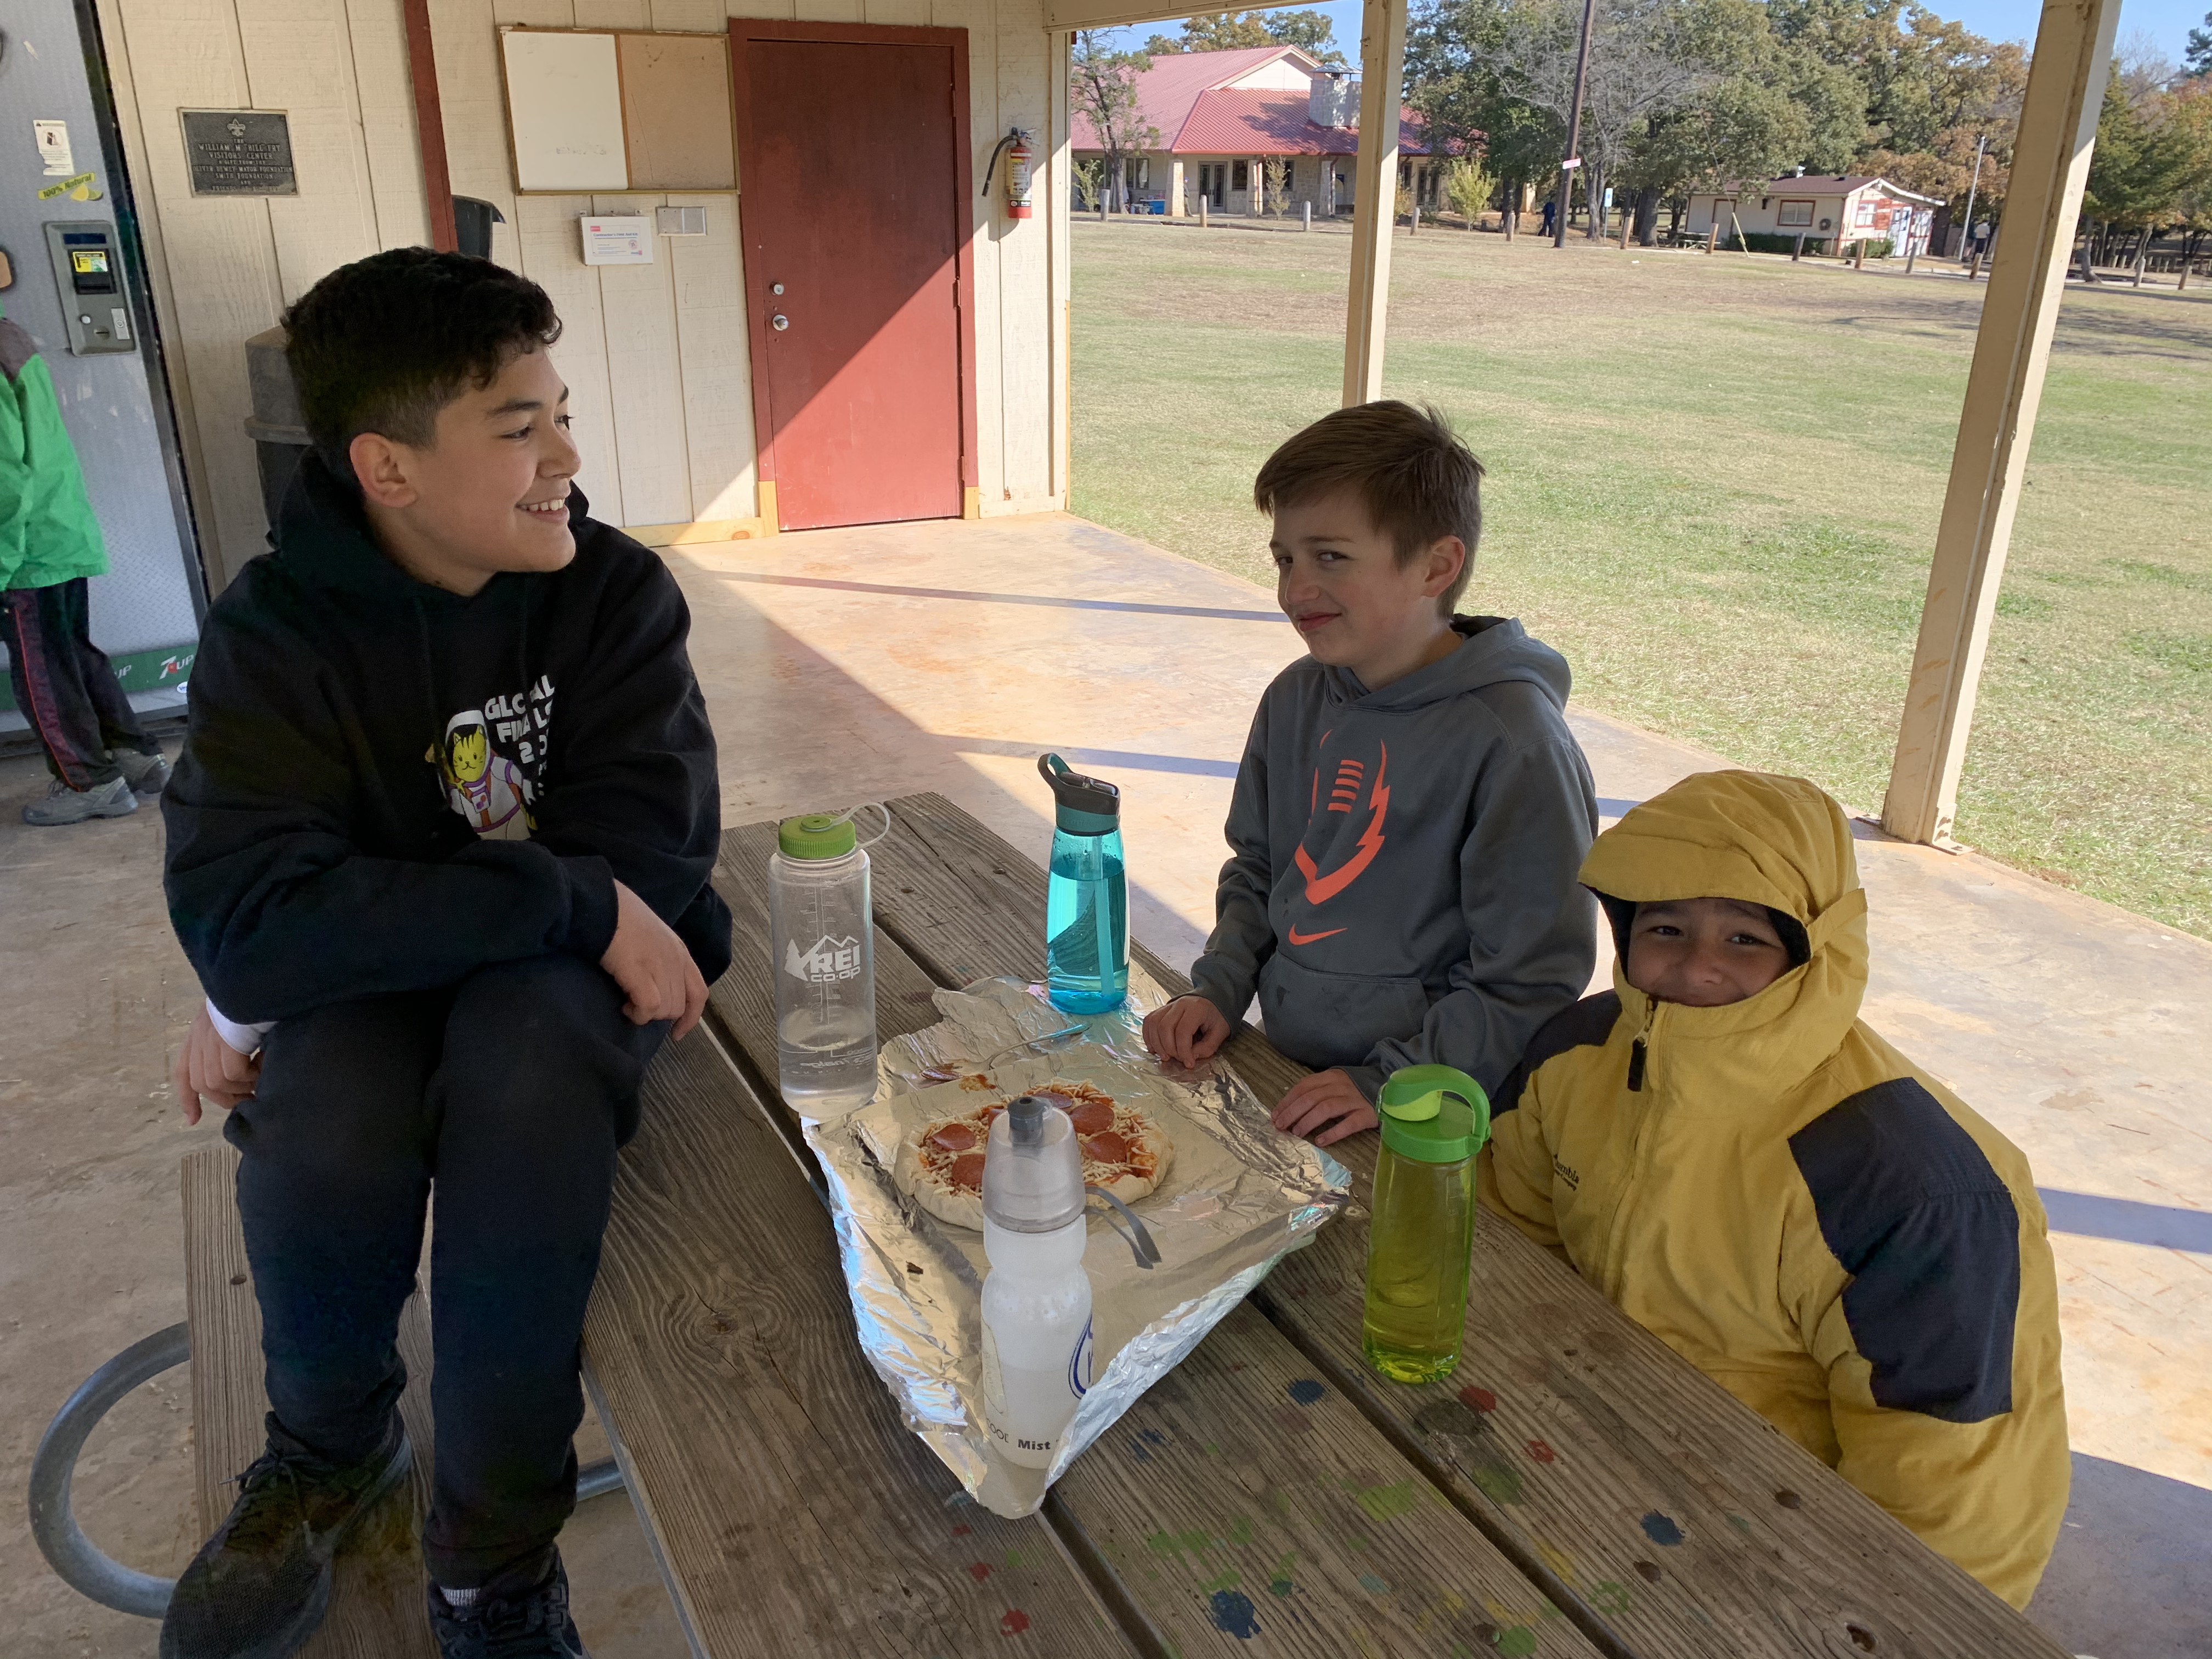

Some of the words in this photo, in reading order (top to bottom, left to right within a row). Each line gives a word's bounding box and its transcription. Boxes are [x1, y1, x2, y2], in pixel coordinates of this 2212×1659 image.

[43, 185, 63, 198] 100%
[64, 173, 92, 188] Natural
[114, 664, 132, 679] UP
[159, 654, 194, 680] 7UP
[810, 944, 860, 974] REI
[1018, 1438, 1051, 1451] Mist
